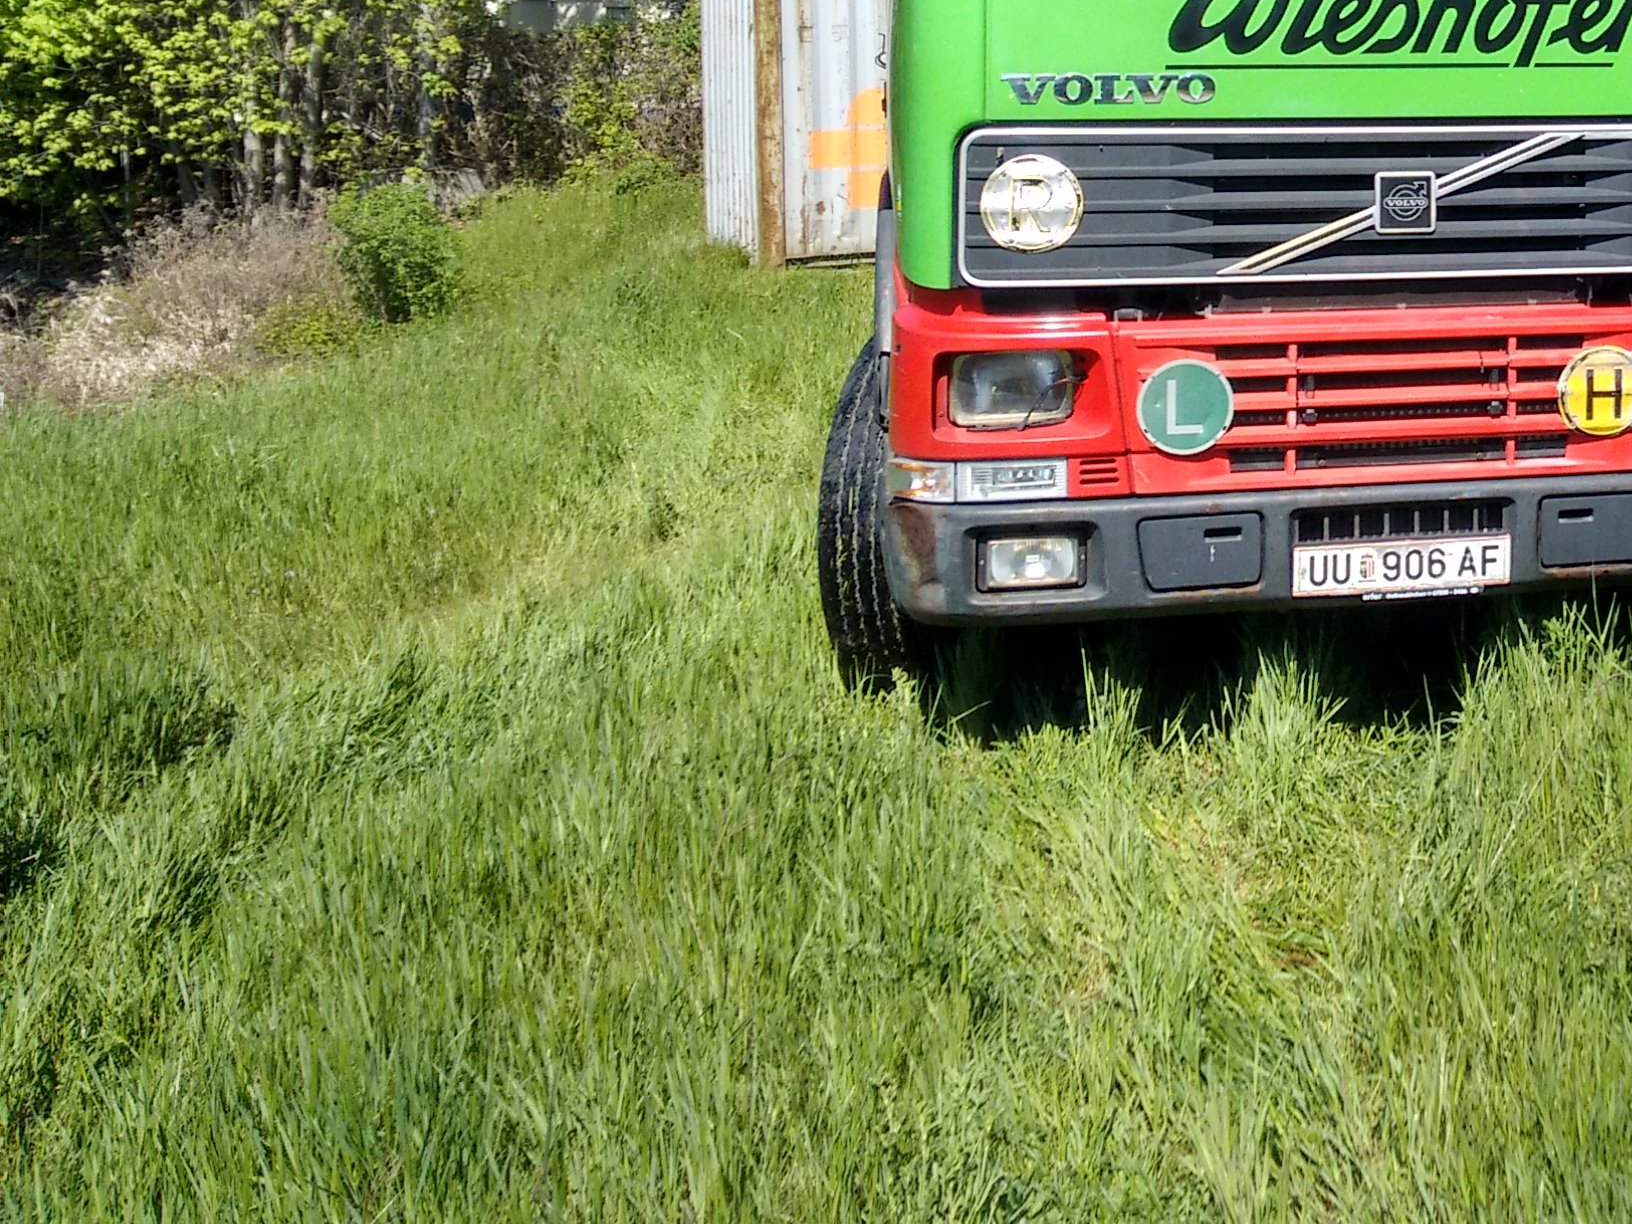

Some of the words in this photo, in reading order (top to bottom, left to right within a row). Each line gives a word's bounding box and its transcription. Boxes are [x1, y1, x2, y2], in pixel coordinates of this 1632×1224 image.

[1000, 73, 1216, 106] VOLVO
[1009, 176, 1053, 232] R
[1387, 199, 1426, 207] VOLVO
[1166, 380, 1203, 435] L
[1586, 369, 1622, 421] H
[1309, 553, 1351, 587] UU
